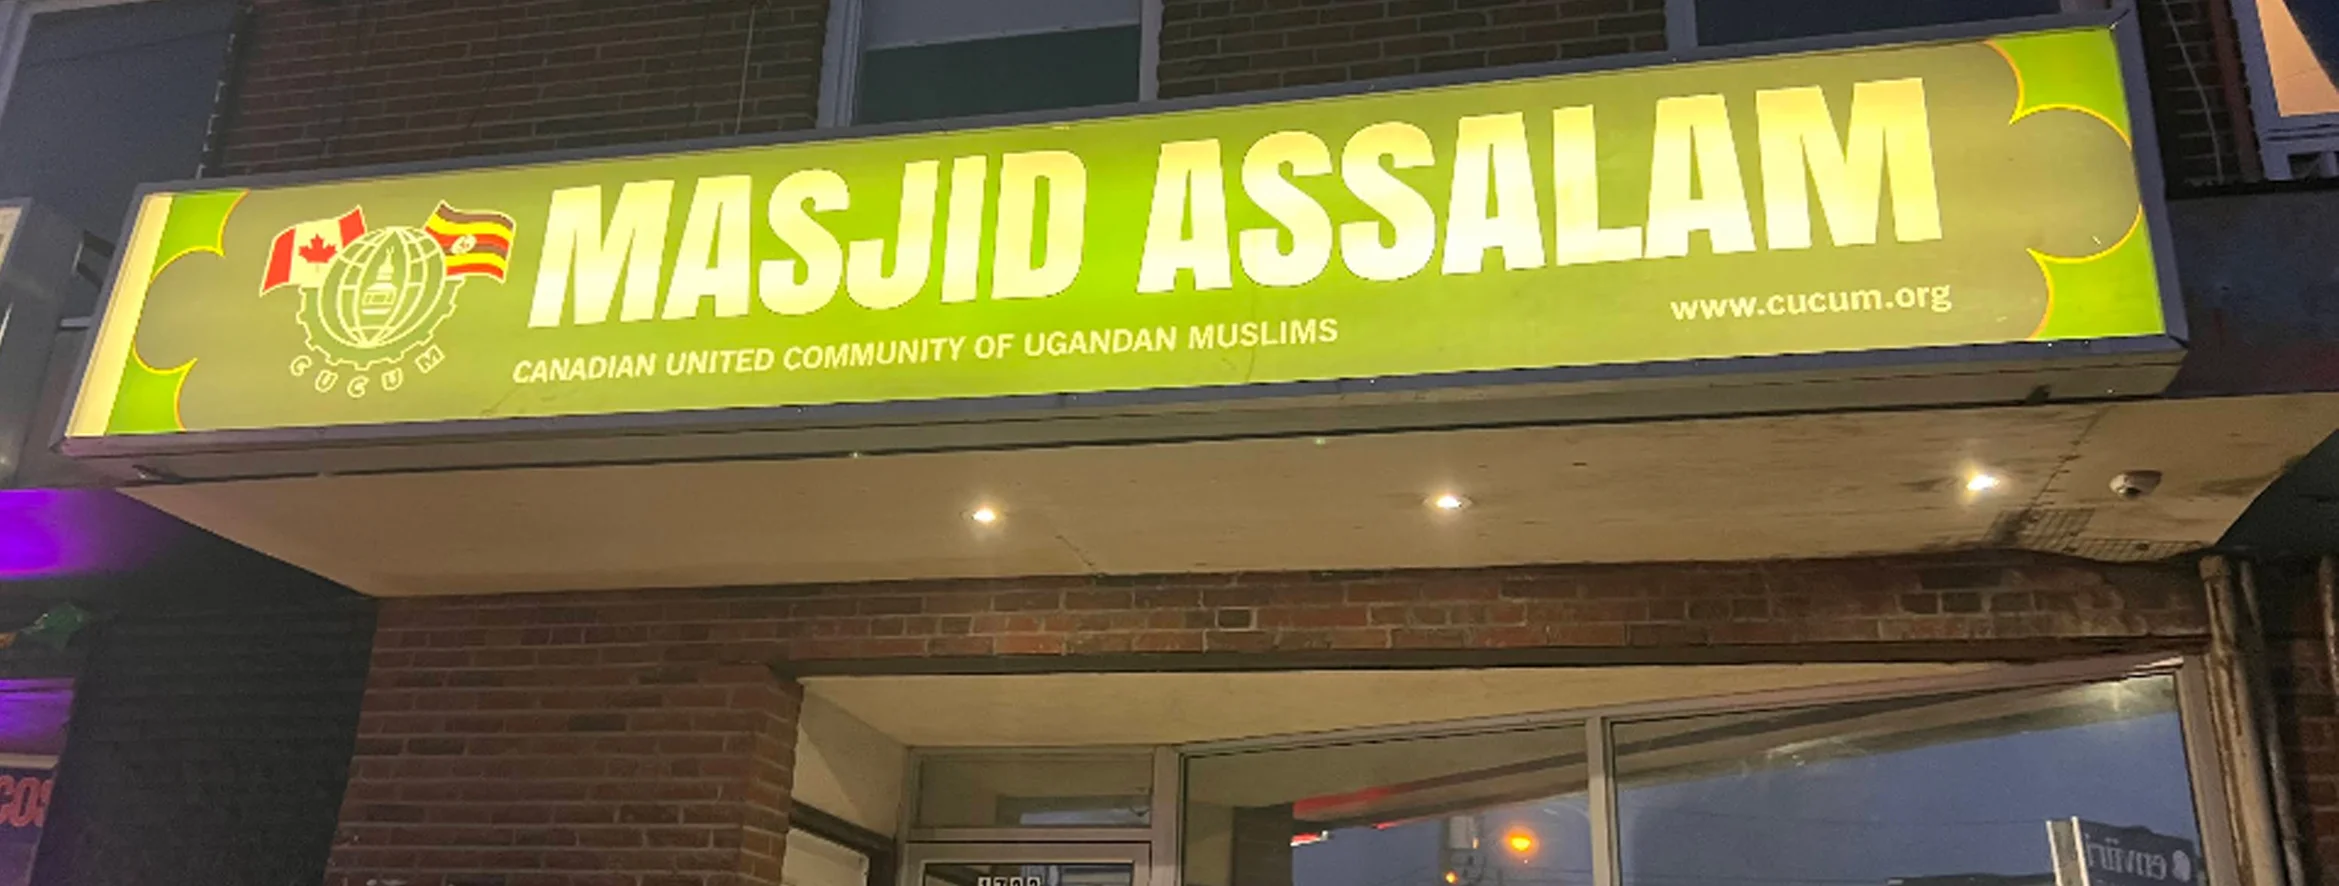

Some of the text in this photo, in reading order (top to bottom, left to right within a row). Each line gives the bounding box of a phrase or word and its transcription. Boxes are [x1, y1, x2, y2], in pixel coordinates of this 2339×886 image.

[528, 77, 1943, 328] MASJID ASSALAM
[1670, 284, 1953, 321] www.cucum.org
[290, 344, 445, 398] CUCUM
[512, 318, 1339, 383] CANADIAN UNITED COMMUNITY OF UGANDAN MUSLIMS
